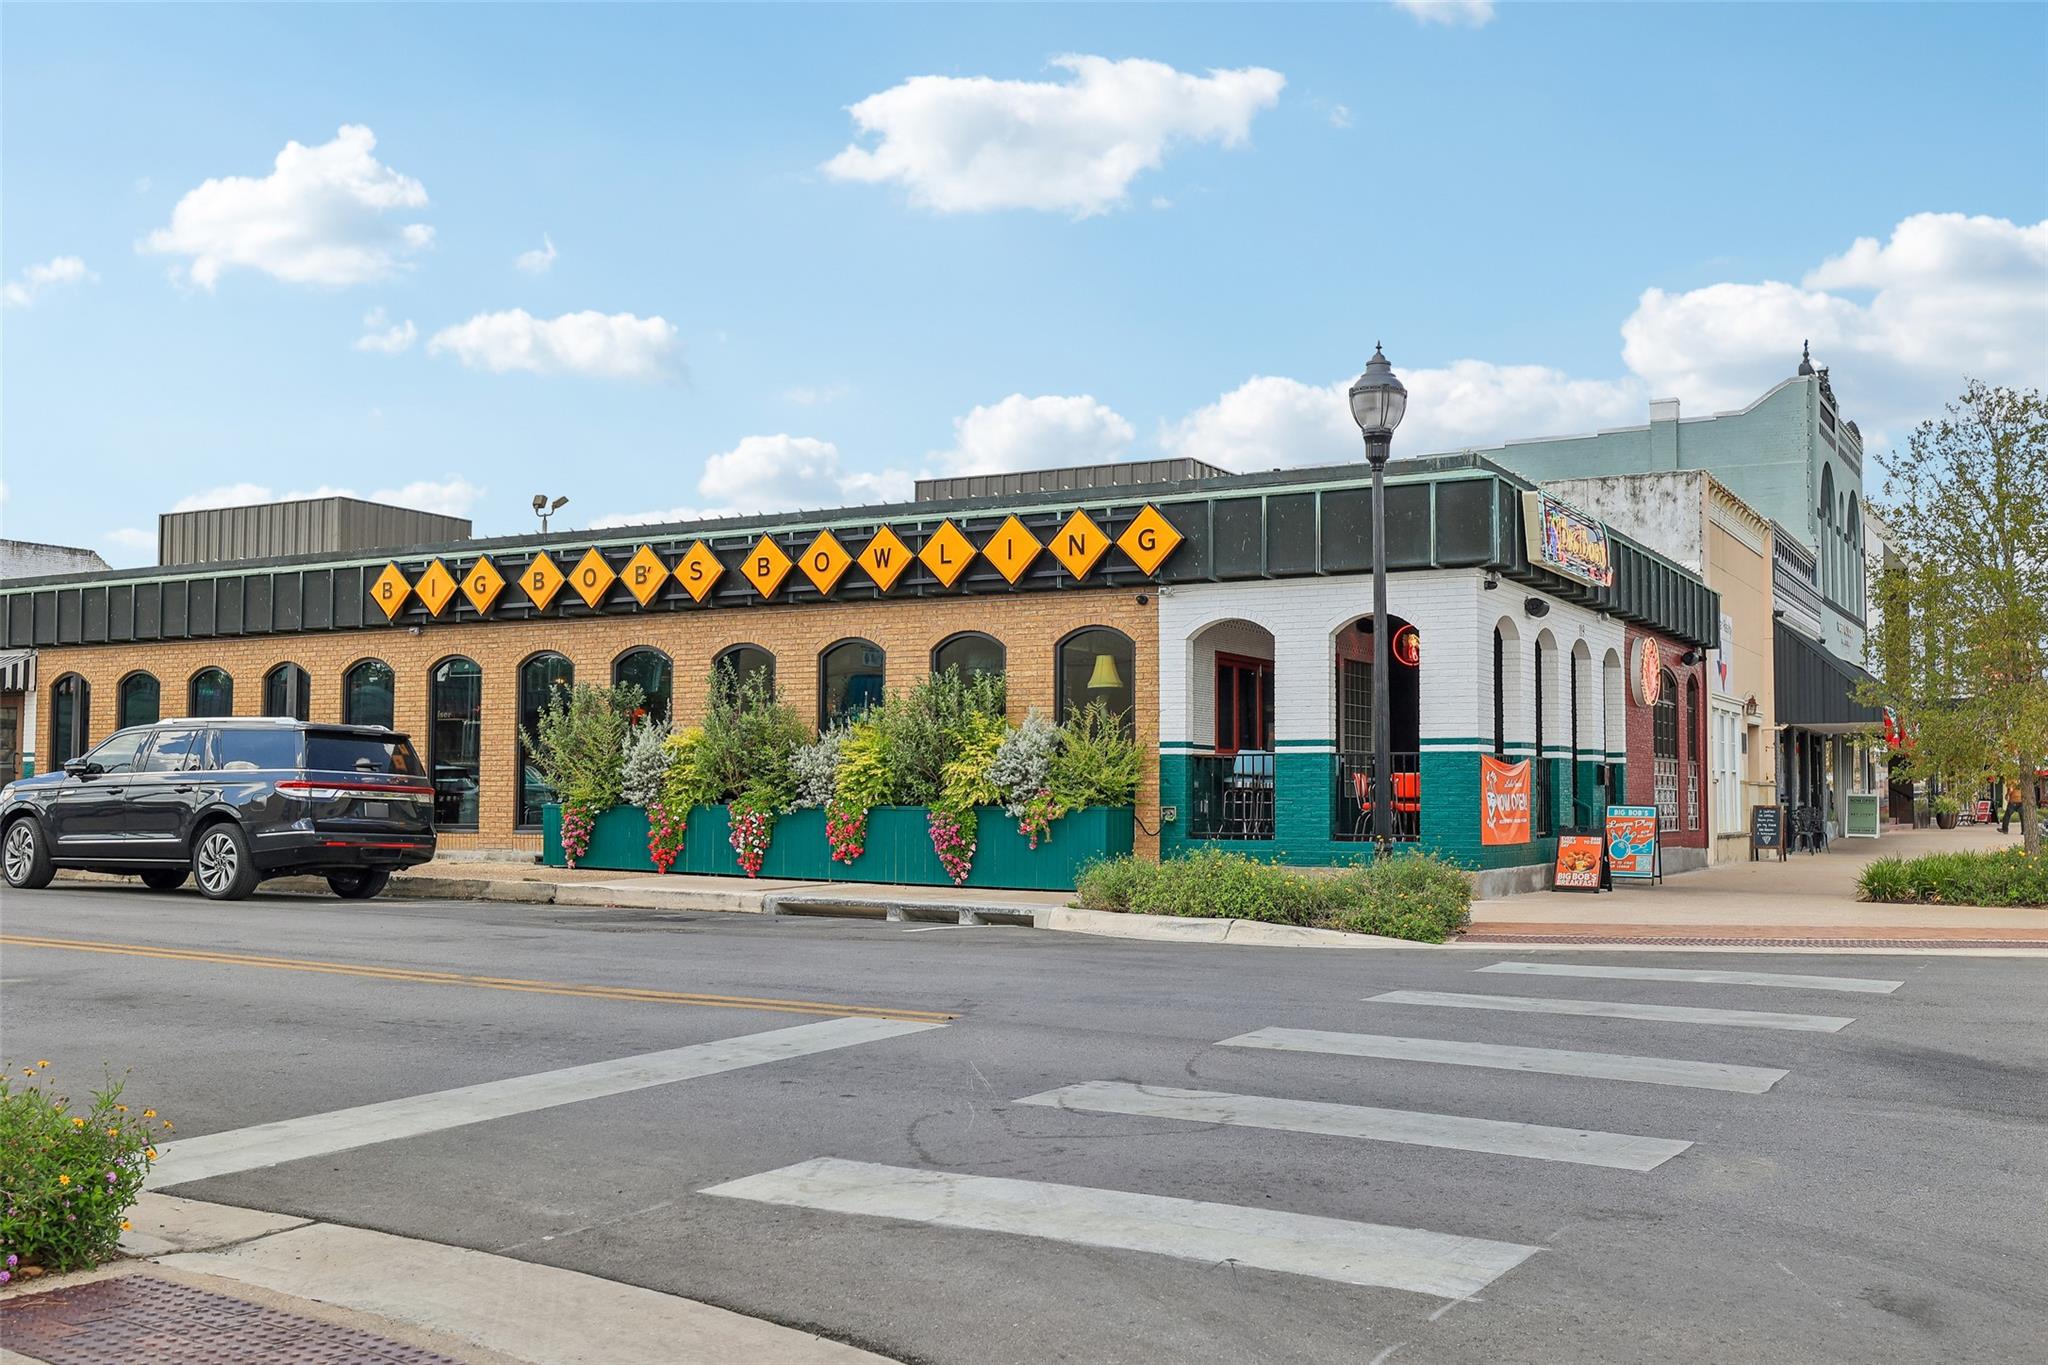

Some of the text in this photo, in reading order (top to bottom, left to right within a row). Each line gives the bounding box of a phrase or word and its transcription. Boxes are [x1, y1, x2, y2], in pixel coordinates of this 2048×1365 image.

[382, 528, 1156, 600] BIG BOB'S BOWLING
[1614, 809, 1649, 817] BIG BOB'S
[1557, 872, 1597, 881] BIG BOB'S
